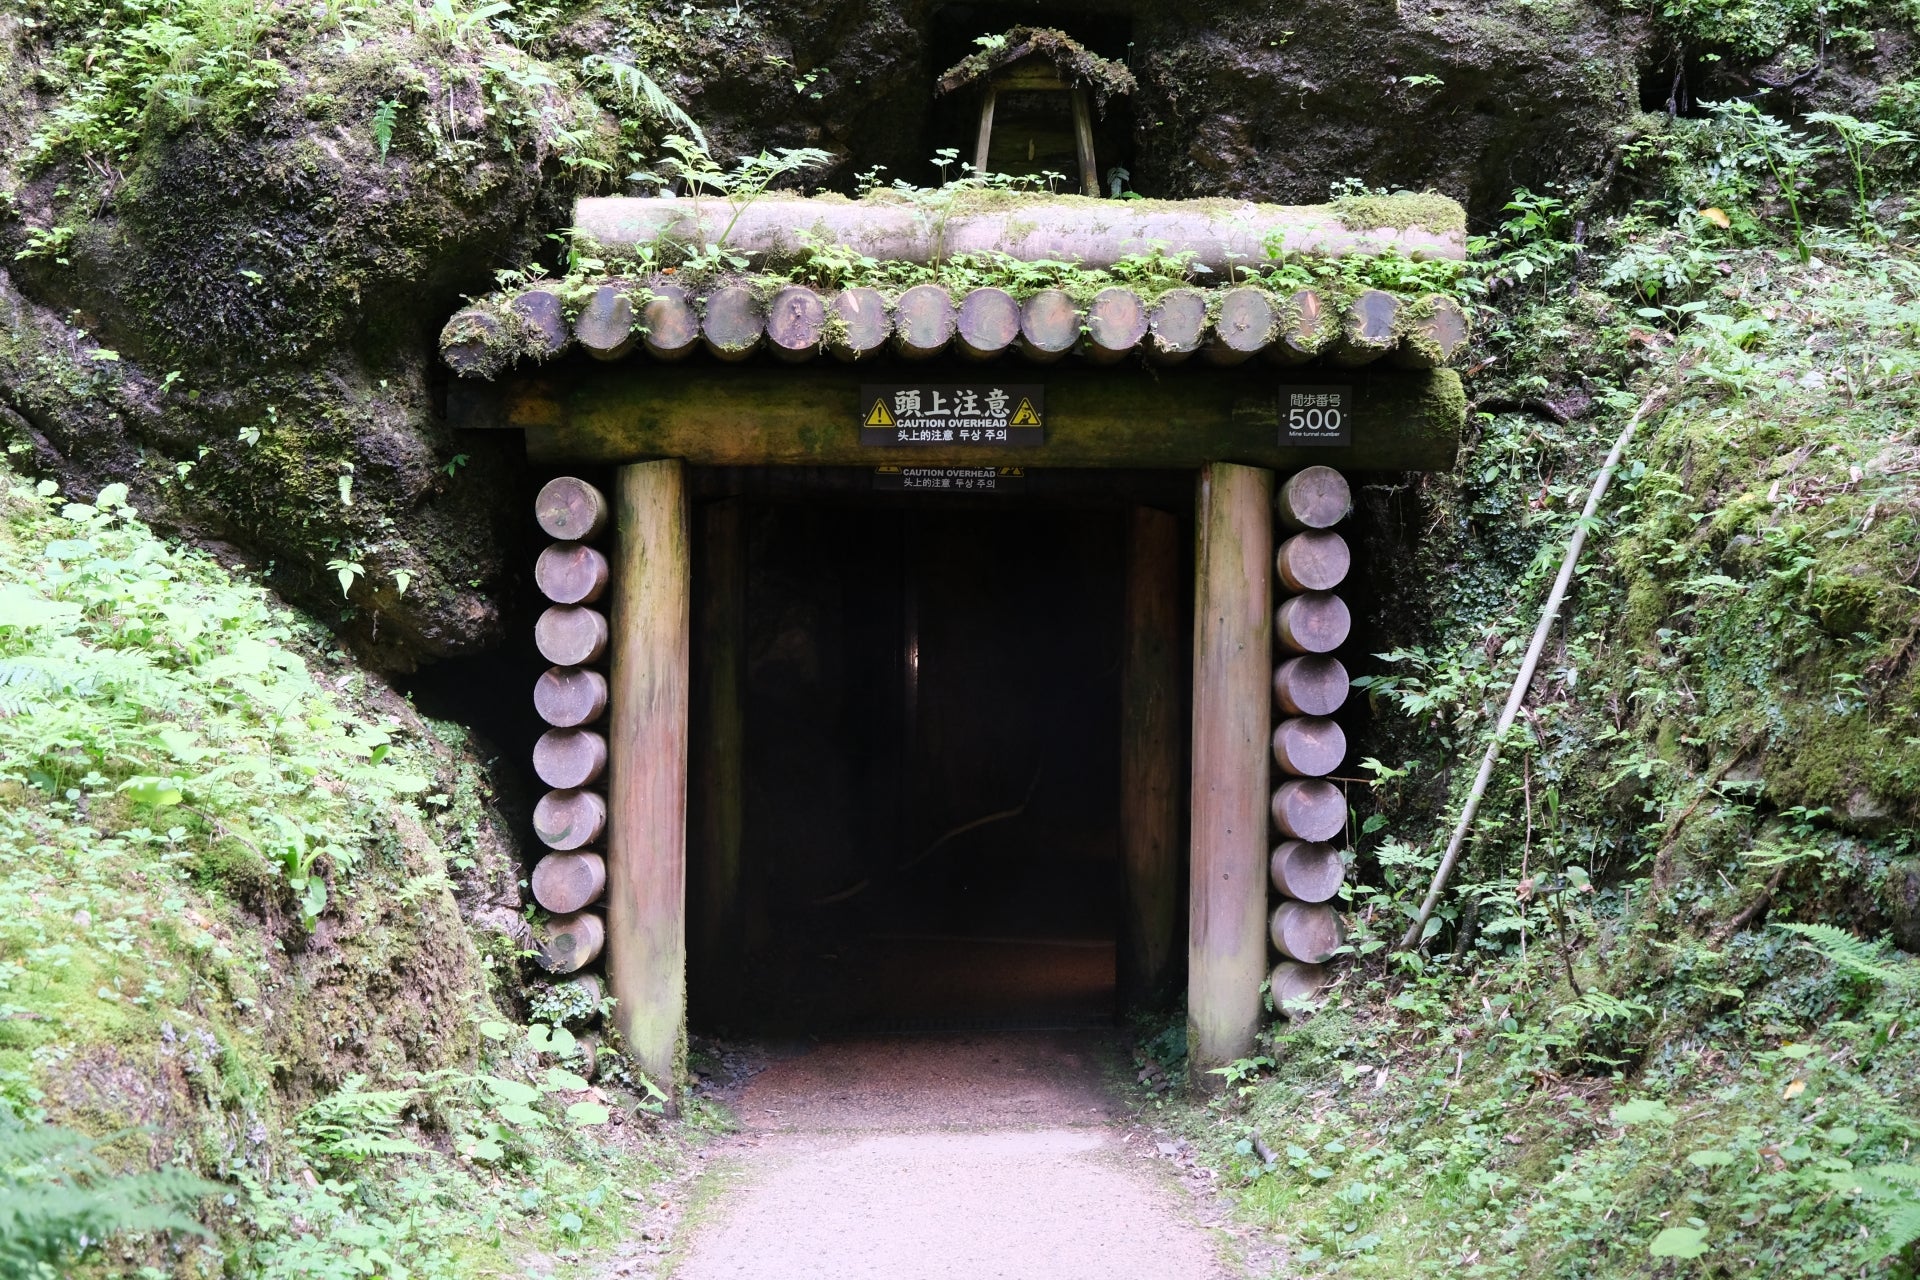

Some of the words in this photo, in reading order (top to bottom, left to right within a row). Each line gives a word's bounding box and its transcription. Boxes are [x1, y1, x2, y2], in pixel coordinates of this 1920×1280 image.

[894, 388, 1010, 418] 頭上注意
[1290, 393, 1341, 407] 間歩番号
[897, 419, 946, 428] CAUTION
[948, 419, 1008, 428] OVERHEAD
[1289, 408, 1341, 430] 500
[897, 430, 954, 441] 头上的注意
[959, 430, 982, 441] 두상
[984, 430, 1007, 441] 주의
[903, 468, 944, 477] CAUTION
[946, 468, 996, 478] OVERHEAD
[903, 478, 951, 488] 头上的注意
